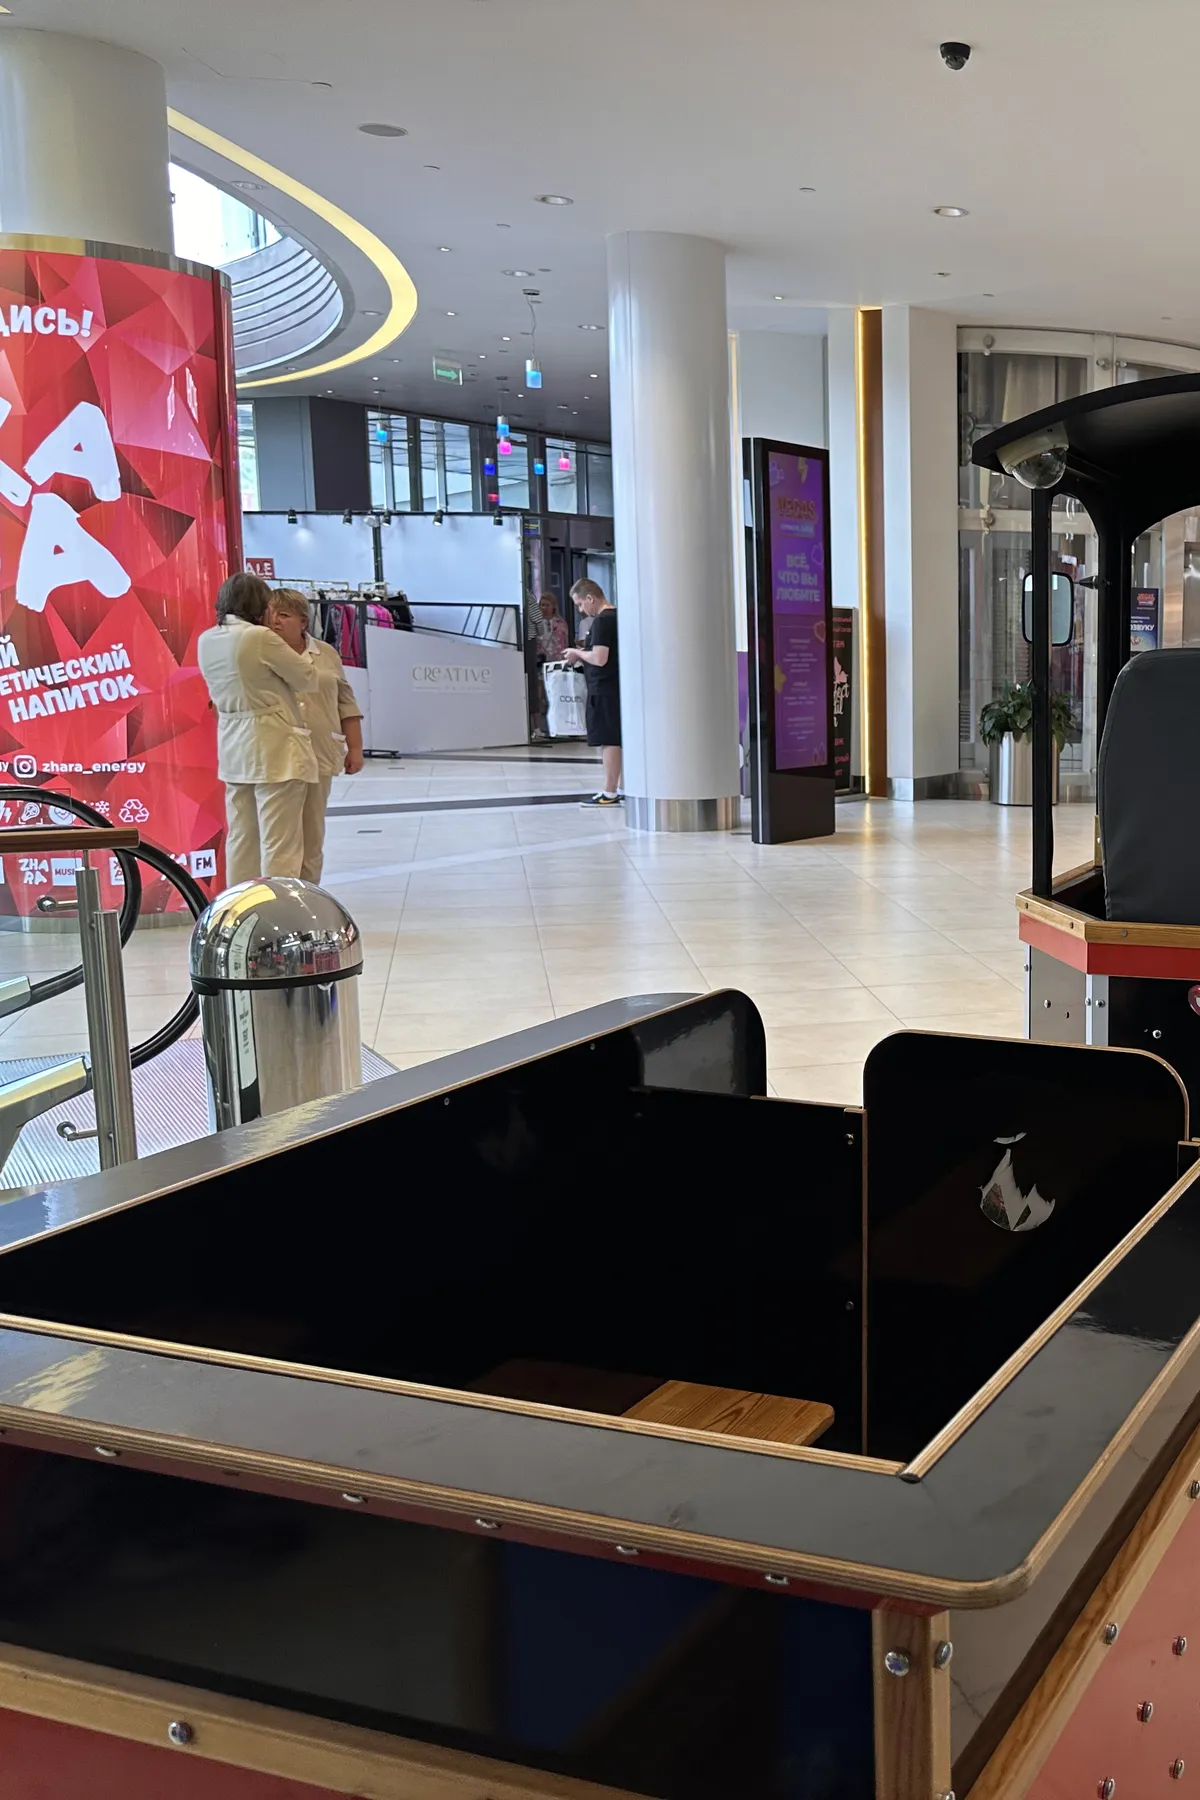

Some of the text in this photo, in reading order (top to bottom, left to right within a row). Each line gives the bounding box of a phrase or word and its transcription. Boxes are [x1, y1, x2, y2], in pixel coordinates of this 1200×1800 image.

[8, 673, 139, 723] НАПИТОК
[42, 761, 146, 774] zhara_energy
[195, 856, 212, 870] FM
[54, 868, 76, 876] MUSI
